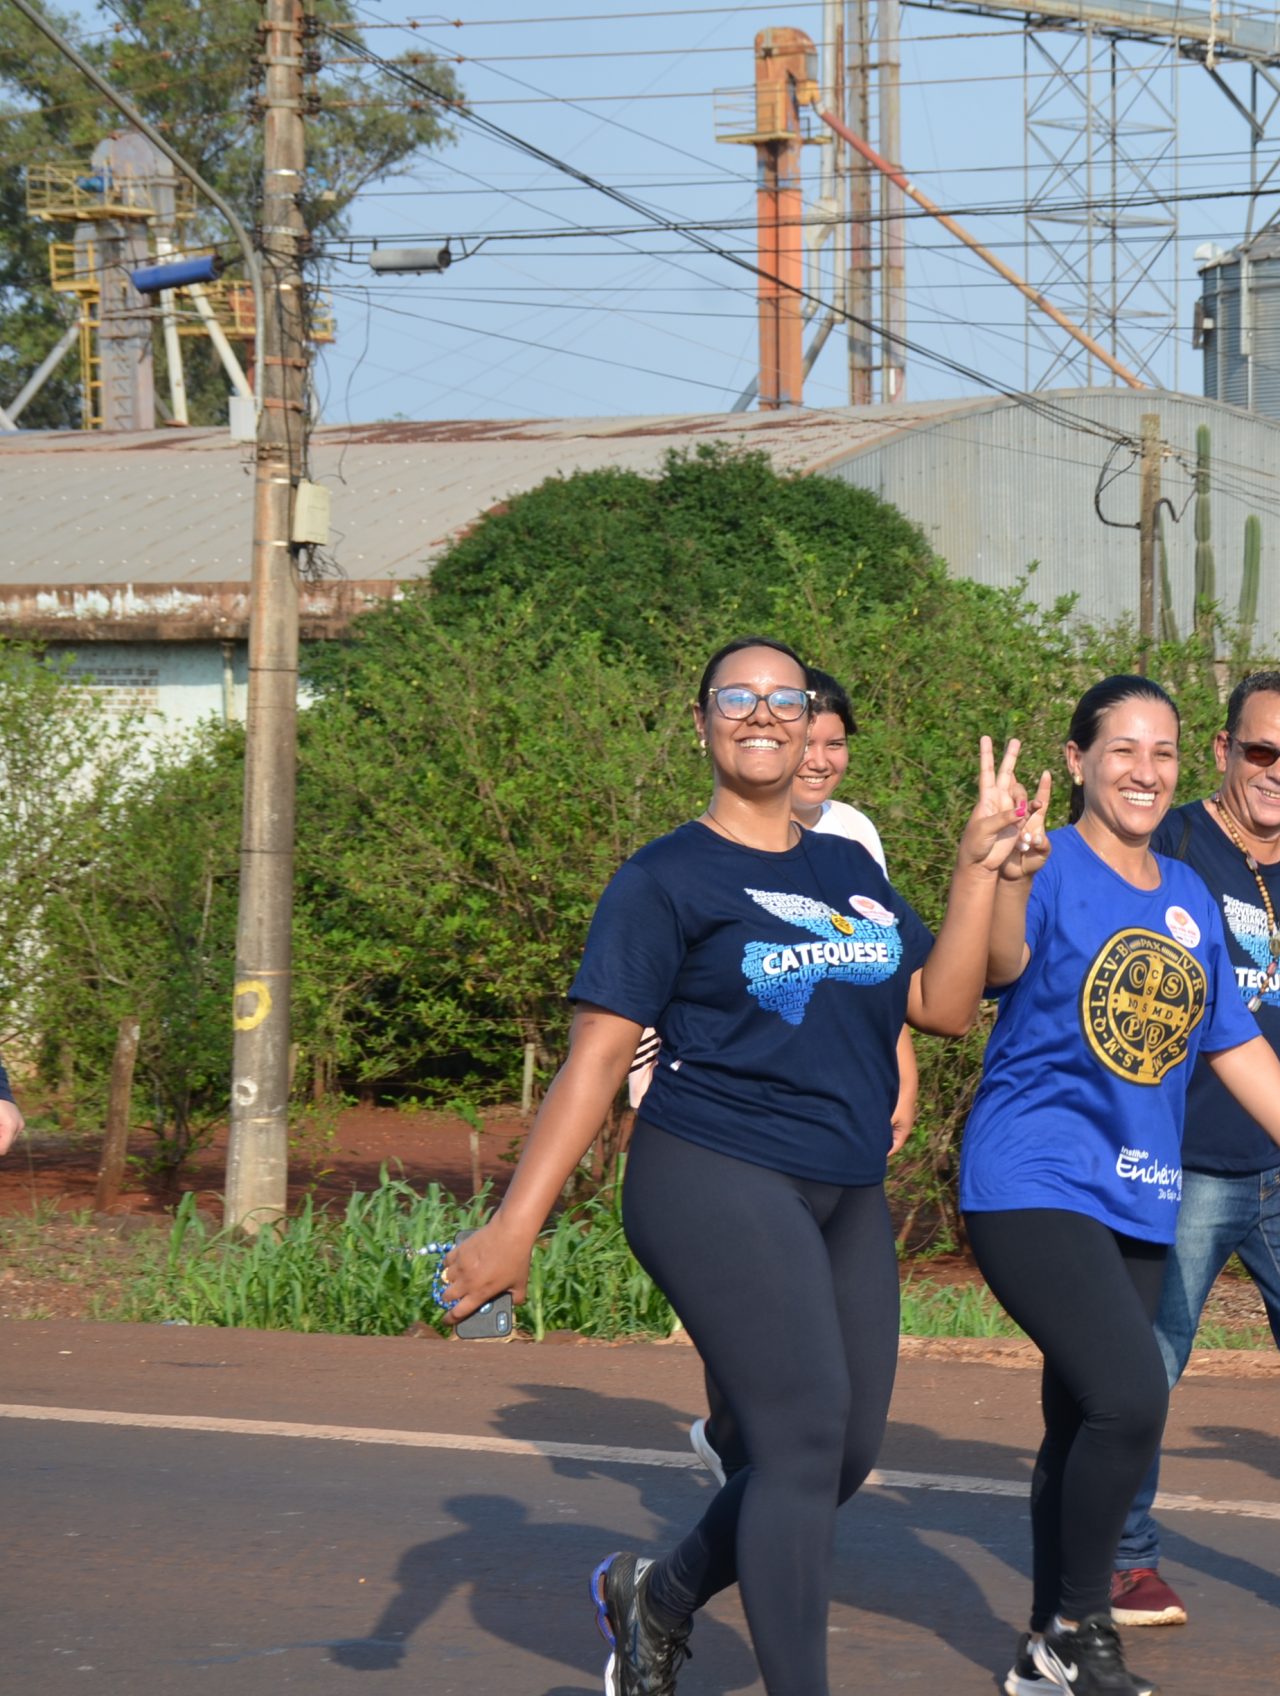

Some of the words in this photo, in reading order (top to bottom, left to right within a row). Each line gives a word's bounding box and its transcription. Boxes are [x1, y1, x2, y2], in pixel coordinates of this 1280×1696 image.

[1140, 938, 1160, 951] PAX
[762, 942, 888, 975] CATEQUESE
[757, 966, 828, 992] DISCÍPULOS
[1121, 1145, 1149, 1160] Instituto
